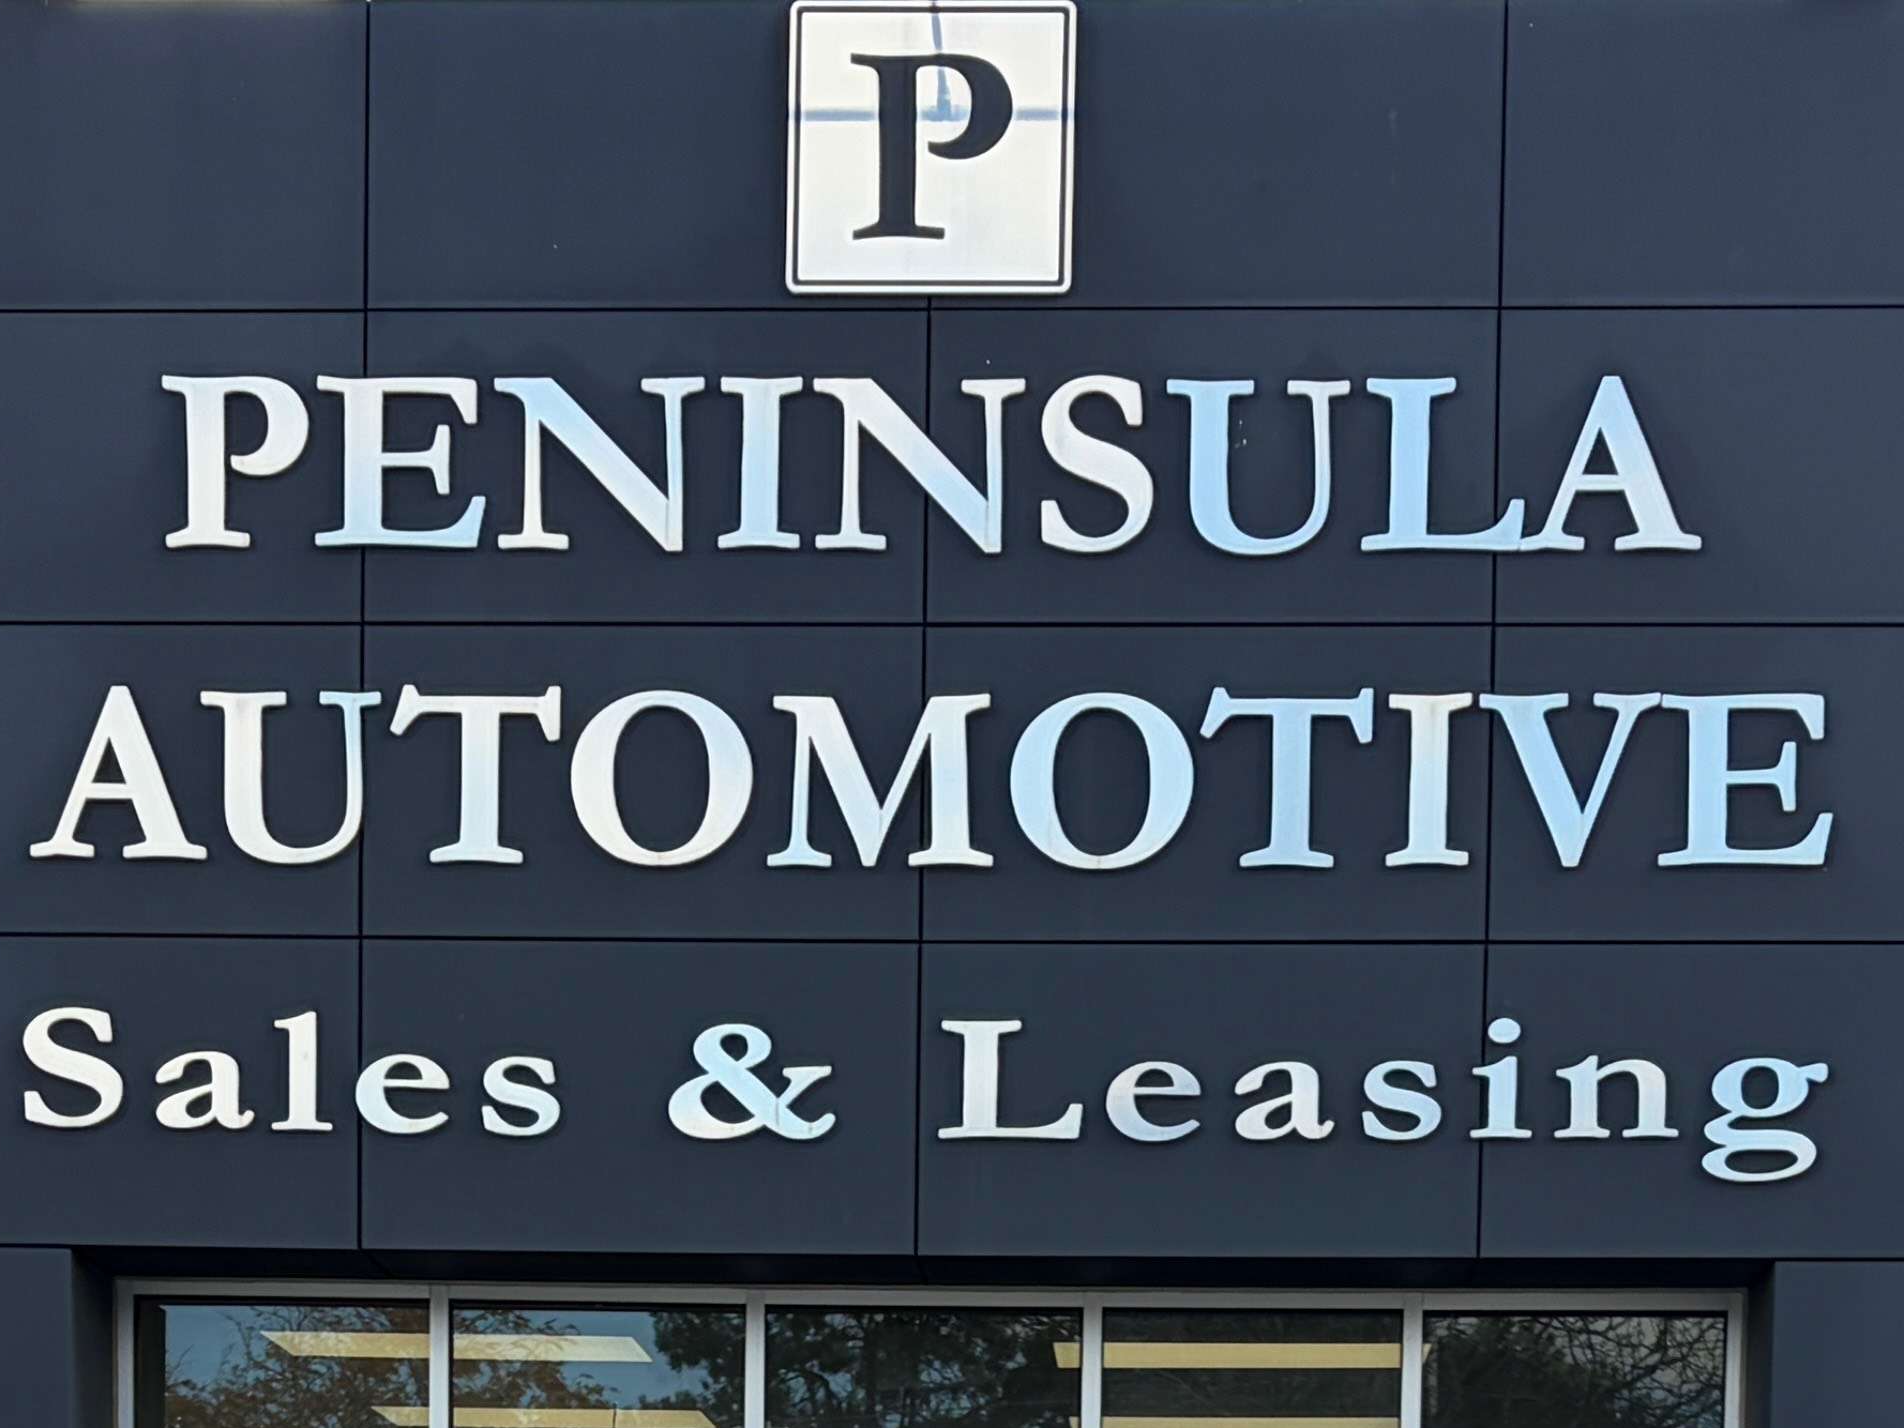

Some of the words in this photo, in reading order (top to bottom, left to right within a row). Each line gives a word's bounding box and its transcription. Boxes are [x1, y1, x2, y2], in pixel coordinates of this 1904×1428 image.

[850, 53, 1013, 240] P
[161, 373, 1703, 556] PENINSULA
[29, 683, 1834, 870] AUTOMOTIVE
[21, 1006, 562, 1137] Sales
[667, 1023, 837, 1141] &
[937, 1017, 1830, 1183] Leasing
